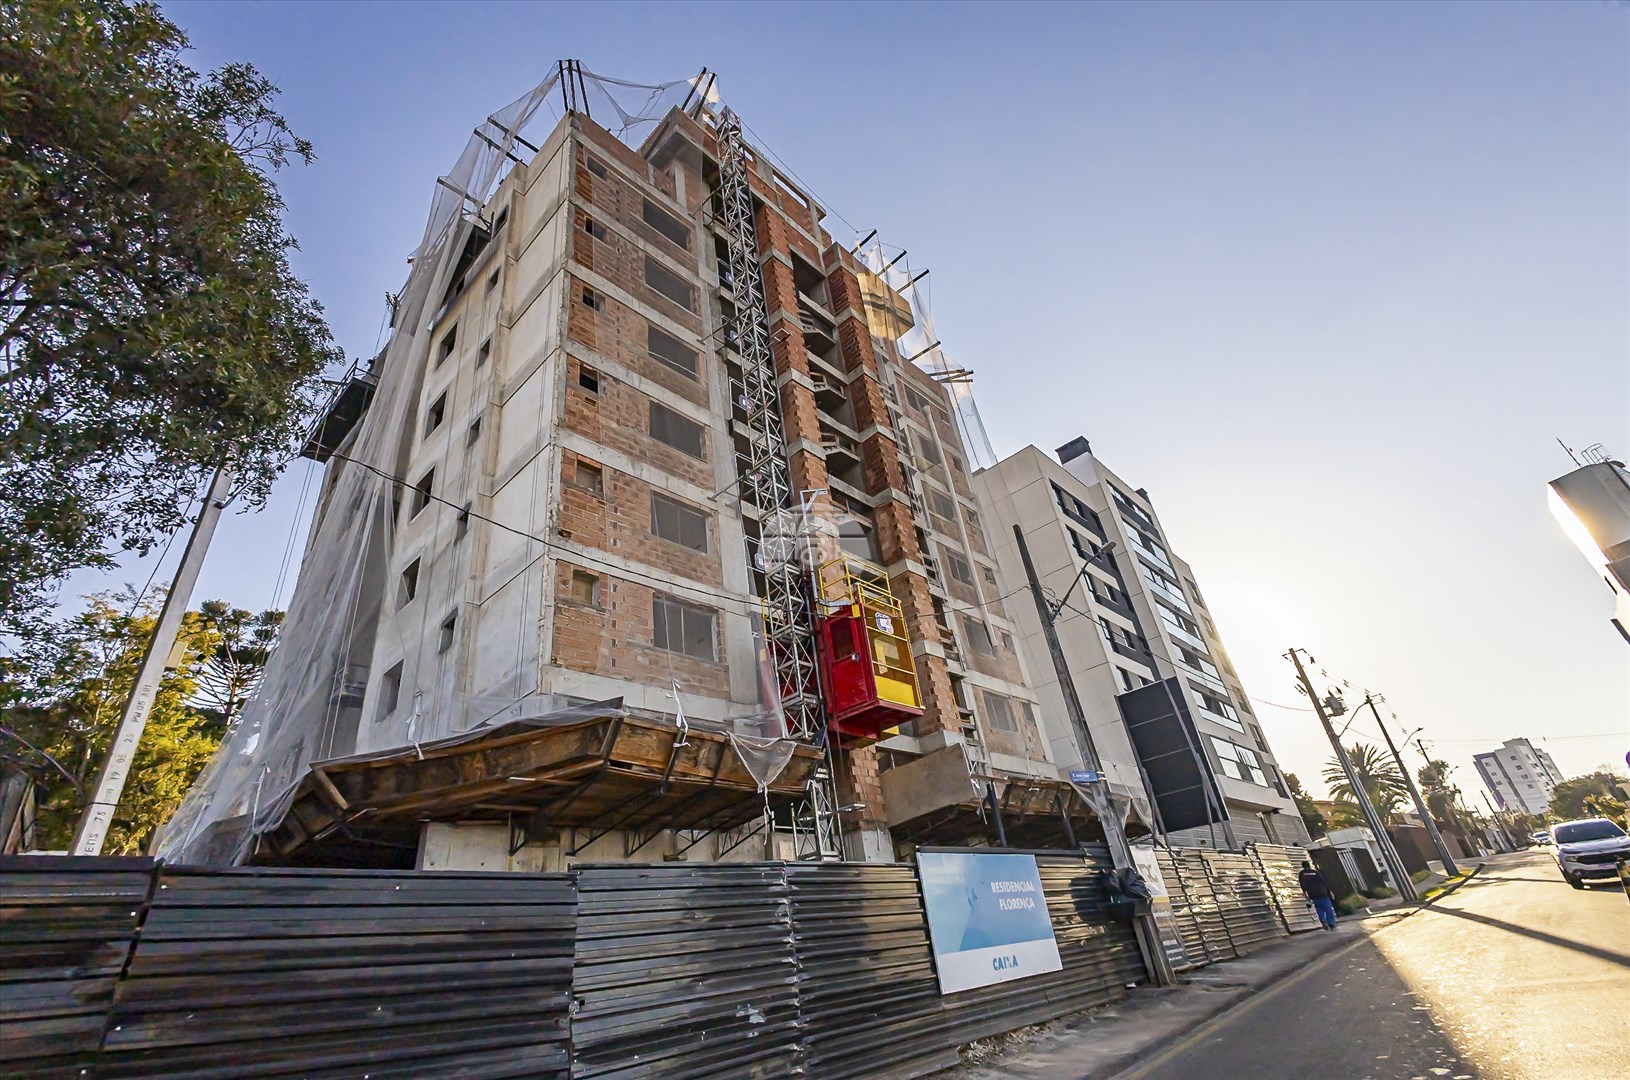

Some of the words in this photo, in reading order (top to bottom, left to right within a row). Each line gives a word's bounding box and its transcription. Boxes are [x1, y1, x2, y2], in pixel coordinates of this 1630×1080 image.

[991, 881, 1035, 893] RESIDENCIAL
[999, 897, 1035, 911] FLORENÇA
[993, 955, 1018, 971] CAIXA
